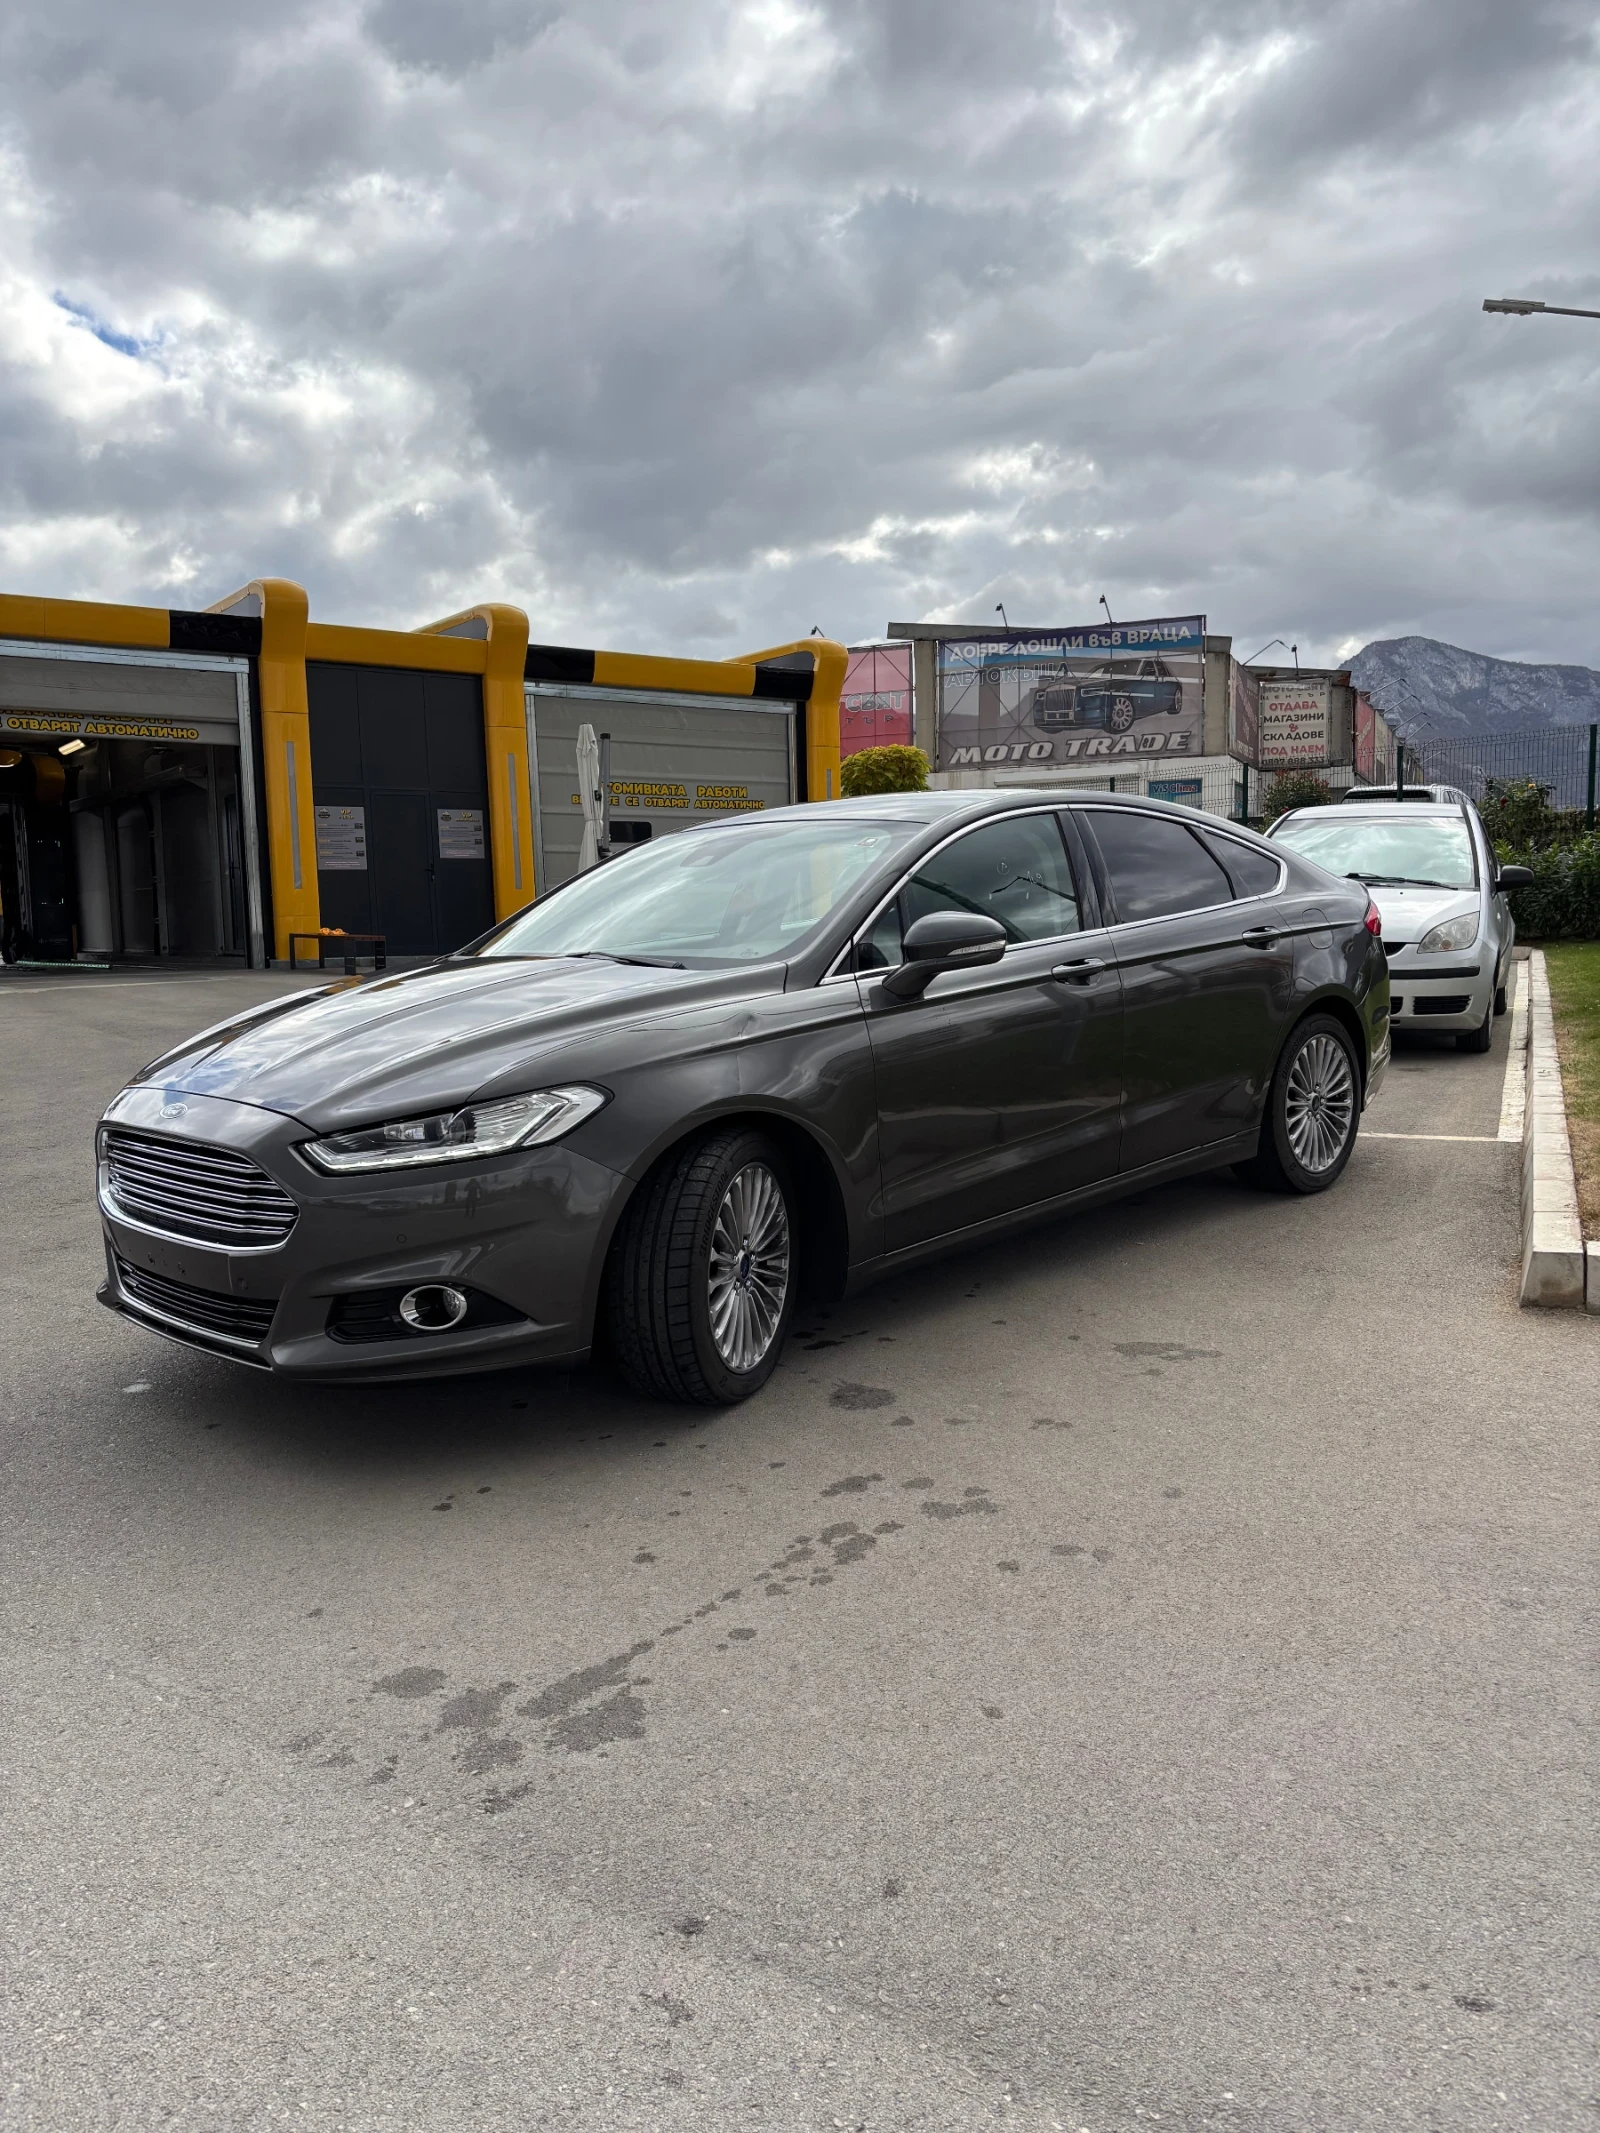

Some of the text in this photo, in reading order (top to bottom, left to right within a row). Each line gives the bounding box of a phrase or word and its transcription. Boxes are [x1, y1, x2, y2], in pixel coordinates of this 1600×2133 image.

[949, 641, 1009, 662] ДОБРЕ
[1013, 635, 1083, 657] ДОШЛИ
[1127, 625, 1192, 644] ВРАЦА
[945, 661, 1073, 688] АВТОКЪЩА
[845, 690, 907, 713] СВЯТ
[1269, 700, 1318, 712] ОТДАВА
[1263, 712, 1325, 724] МАГАЗИНИ
[7, 717, 81, 733] ОТВАРЯТ
[85, 722, 199, 740] АВТОМАТИЧНО
[1263, 730, 1325, 742] СКЛАДОВЕ
[948, 730, 1192, 765] MOTO TRADE
[1262, 744, 1325, 756] ПОД НАЕМ
[607, 782, 748, 798] ОМИВКАТА РАБОТИ
[625, 797, 639, 807] СЕ
[644, 797, 690, 808] ОТВАРЯТ
[694, 800, 765, 810] АВТОМАТИЧНО
[699, 1167, 729, 1258] BRIDGESTONE
